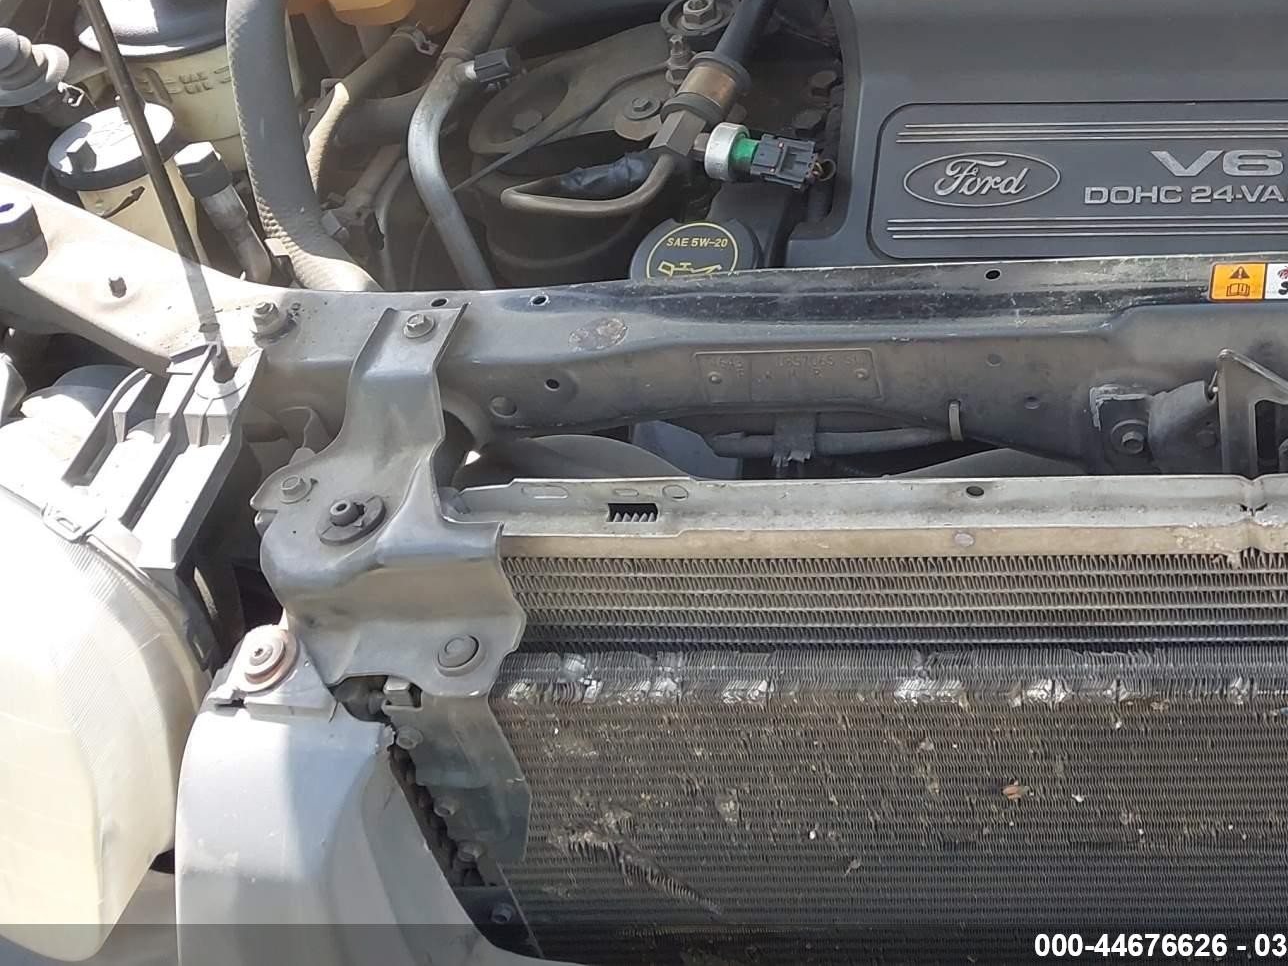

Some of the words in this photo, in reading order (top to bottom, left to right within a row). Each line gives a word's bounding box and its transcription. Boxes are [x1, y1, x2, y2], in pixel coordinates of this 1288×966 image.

[1151, 149, 1284, 177] V6
[933, 157, 1031, 196] Ford
[1083, 186, 1183, 206] DOHC
[666, 237, 689, 248] SAE
[690, 237, 729, 248] 5W-20
